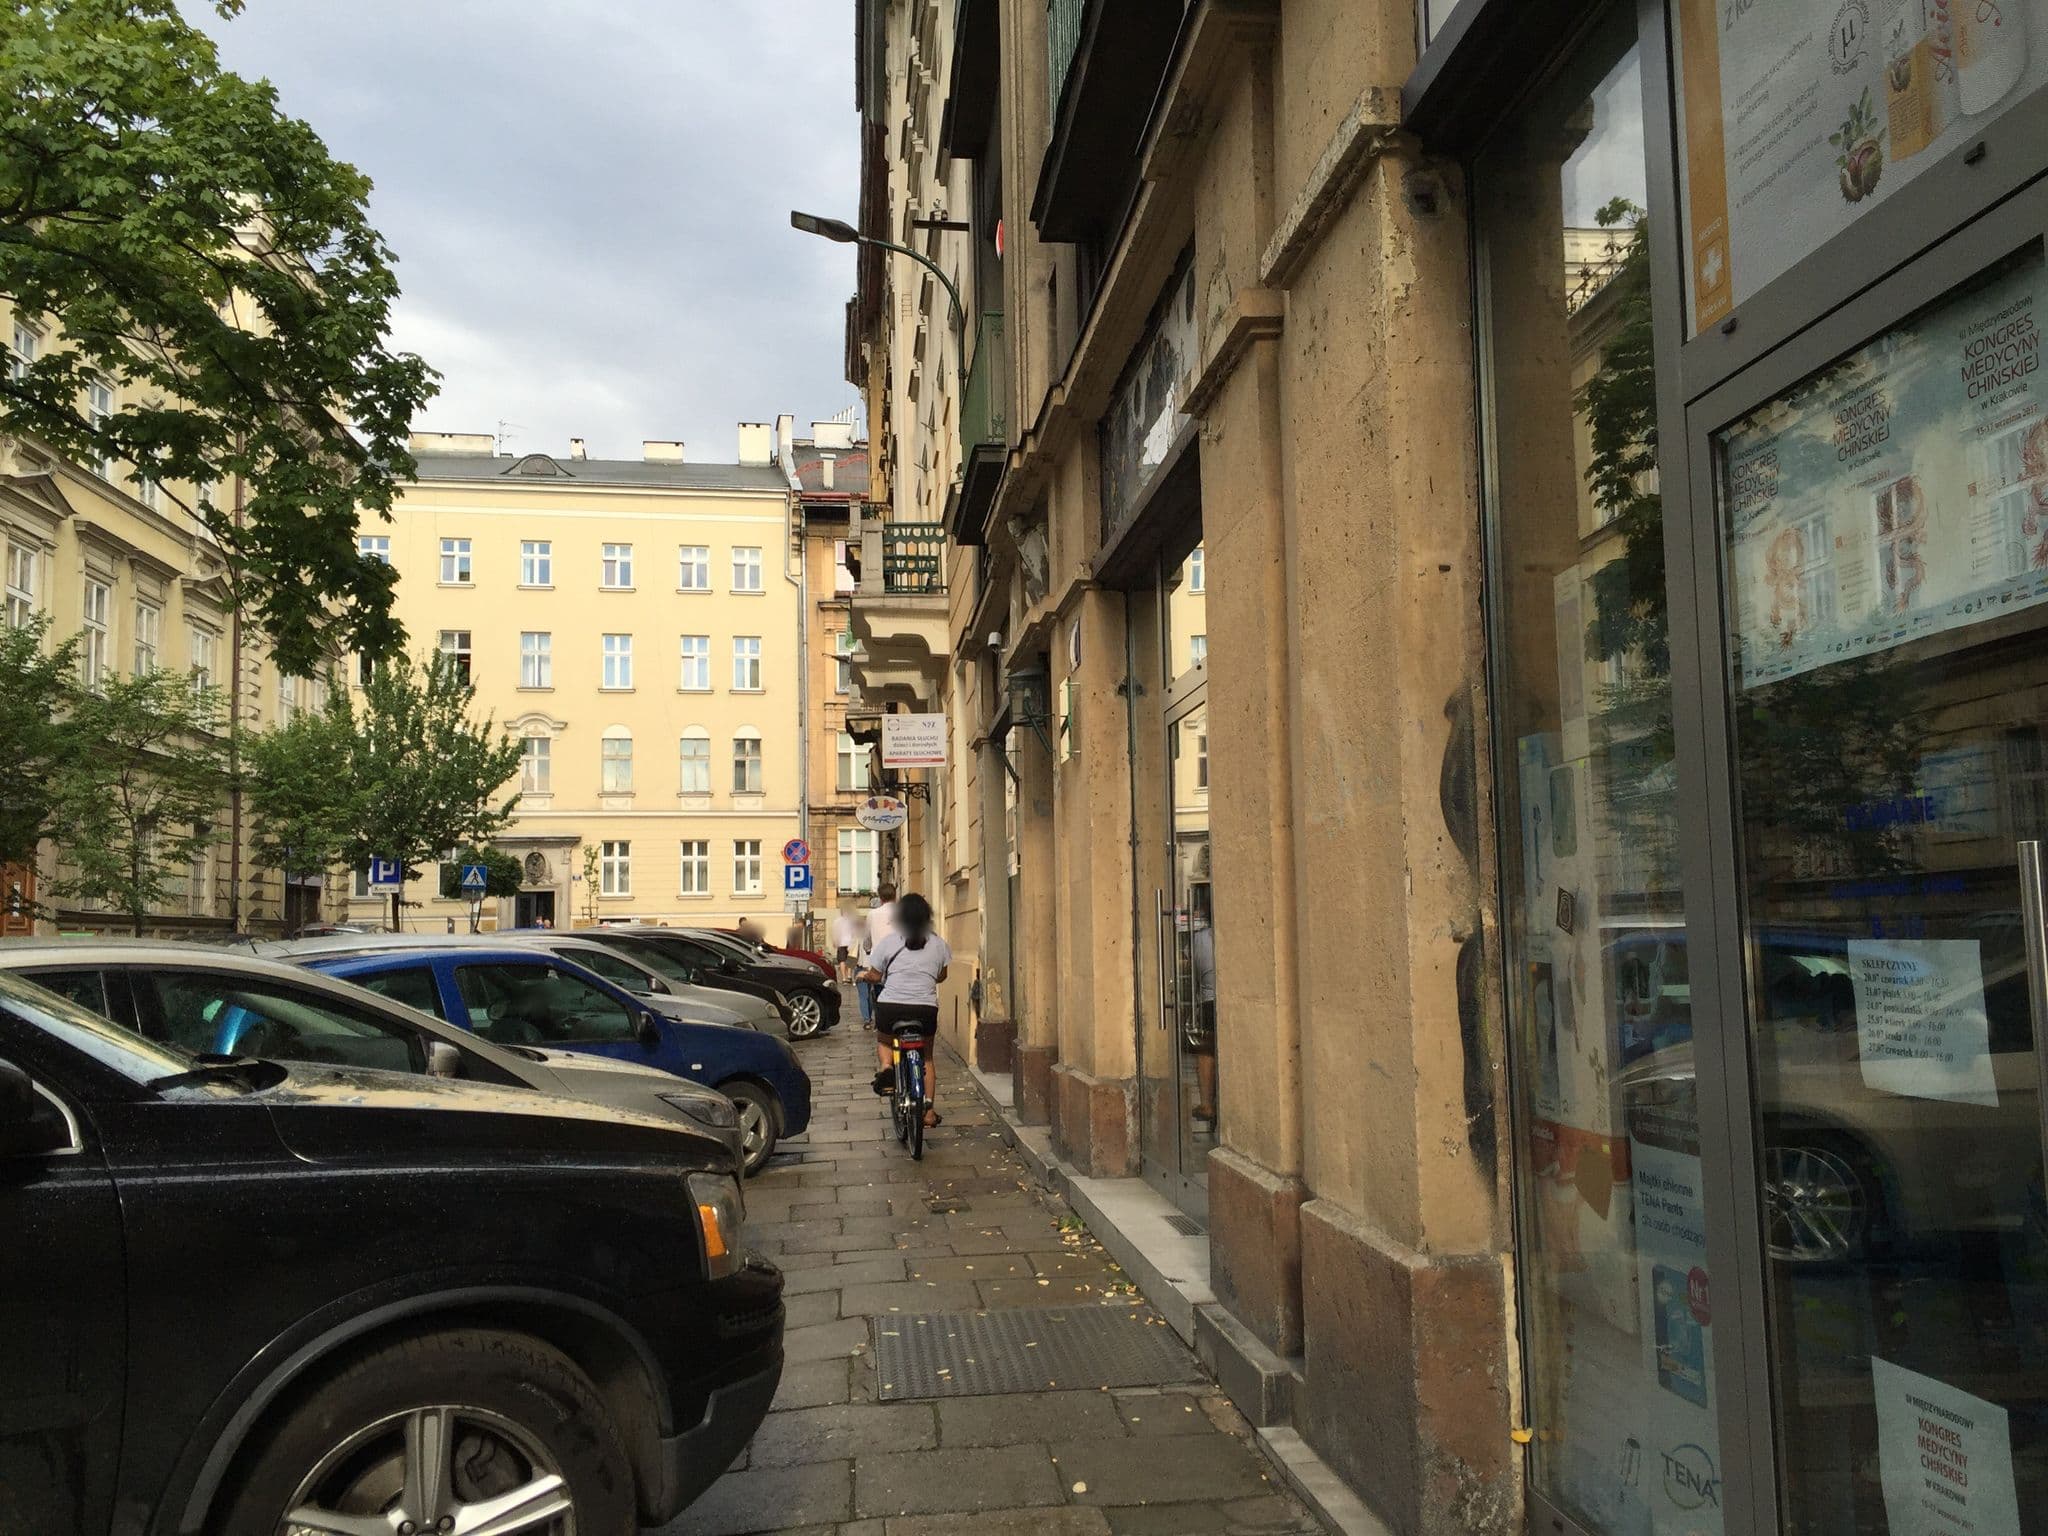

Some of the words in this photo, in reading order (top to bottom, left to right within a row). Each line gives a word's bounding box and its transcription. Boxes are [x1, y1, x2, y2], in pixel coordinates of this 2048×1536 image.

[1964, 311, 2035, 362] KONGRES
[1960, 330, 2041, 383] MEDYCYNY
[1967, 352, 2041, 400] CHIŃSKIEJ
[1990, 383, 2029, 408] Krakowie
[1833, 404, 1892, 448] MEDYCYNY
[378, 860, 395, 881] P
[789, 866, 805, 888] P
[1918, 1417, 1961, 1449] KONGRES
[1918, 1435, 1968, 1469] MEDYCYNY
[1660, 1451, 1720, 1508] TENA
